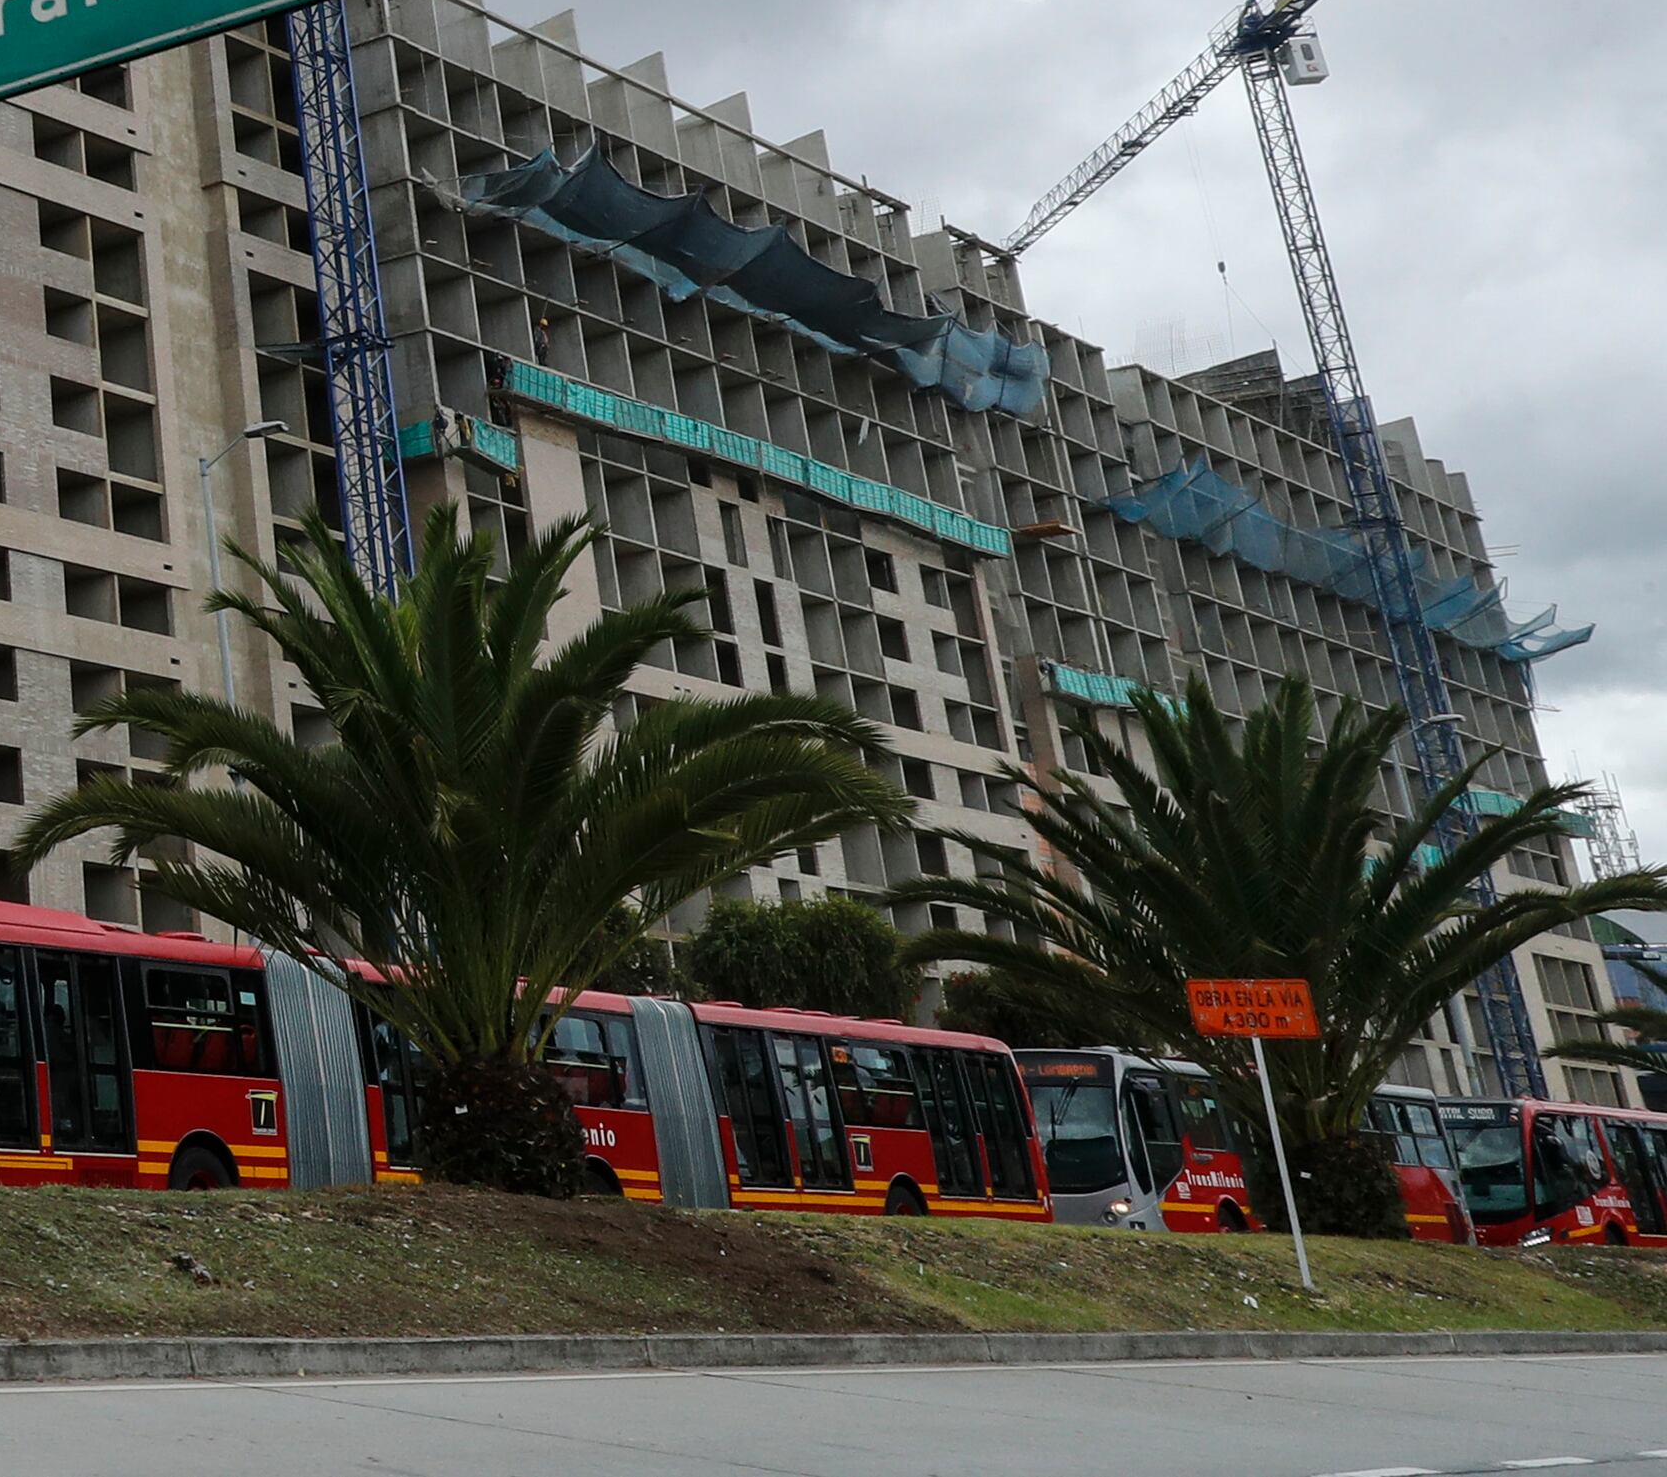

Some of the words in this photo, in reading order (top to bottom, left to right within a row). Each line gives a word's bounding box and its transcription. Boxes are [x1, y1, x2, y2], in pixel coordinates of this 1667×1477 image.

[1195, 990, 1231, 1006] OBRA
[1235, 990, 1253, 1006] EN
[1258, 990, 1276, 1007] LA
